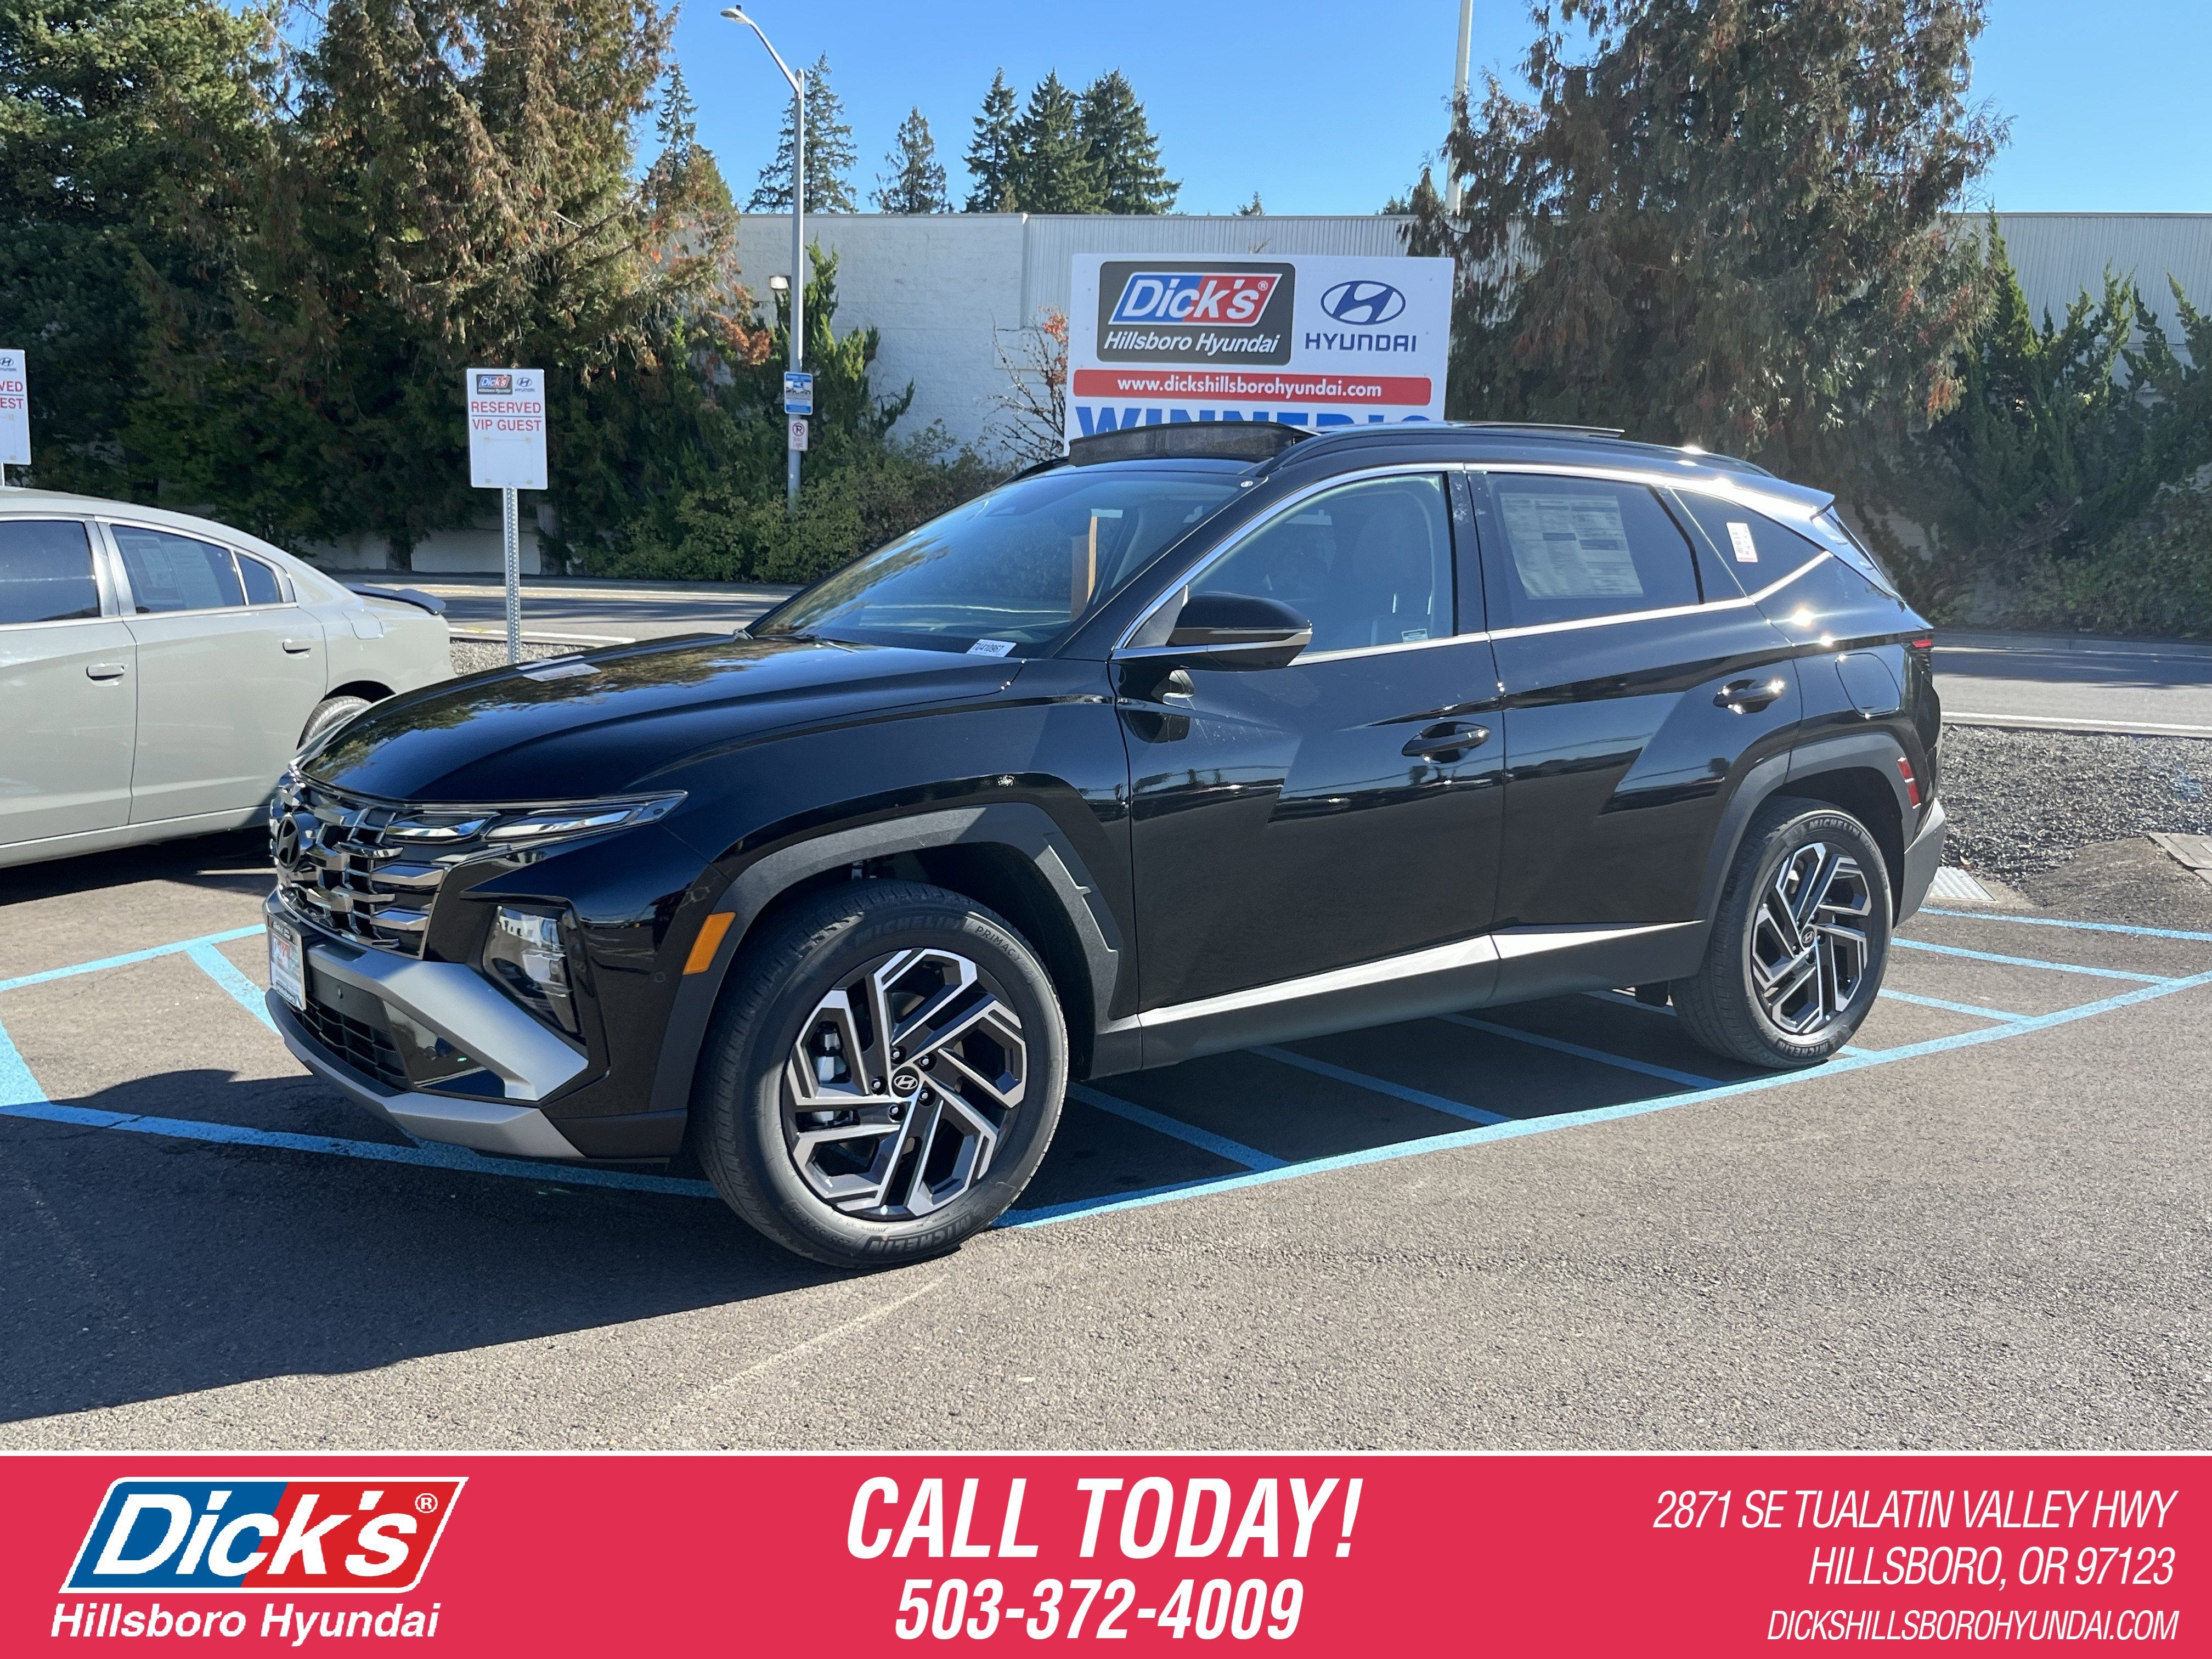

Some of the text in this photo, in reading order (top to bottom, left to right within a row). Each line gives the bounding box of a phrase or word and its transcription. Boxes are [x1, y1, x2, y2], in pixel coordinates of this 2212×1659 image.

[1121, 279, 1261, 320] Dick's
[1103, 331, 1280, 356] Hillsboro Hyundai
[1305, 332, 1416, 352] HYUNDAI
[1117, 376, 1382, 398] www.dickshillsborohyundai.com
[471, 401, 541, 414] RESERVED
[472, 419, 541, 431] VIP GUEST
[1809, 819, 1860, 837] MICHELIN
[974, 925, 1024, 962] PRIMACY
[1776, 1040, 1829, 1058] MICHELIN
[868, 1215, 972, 1255] MICHELIN
